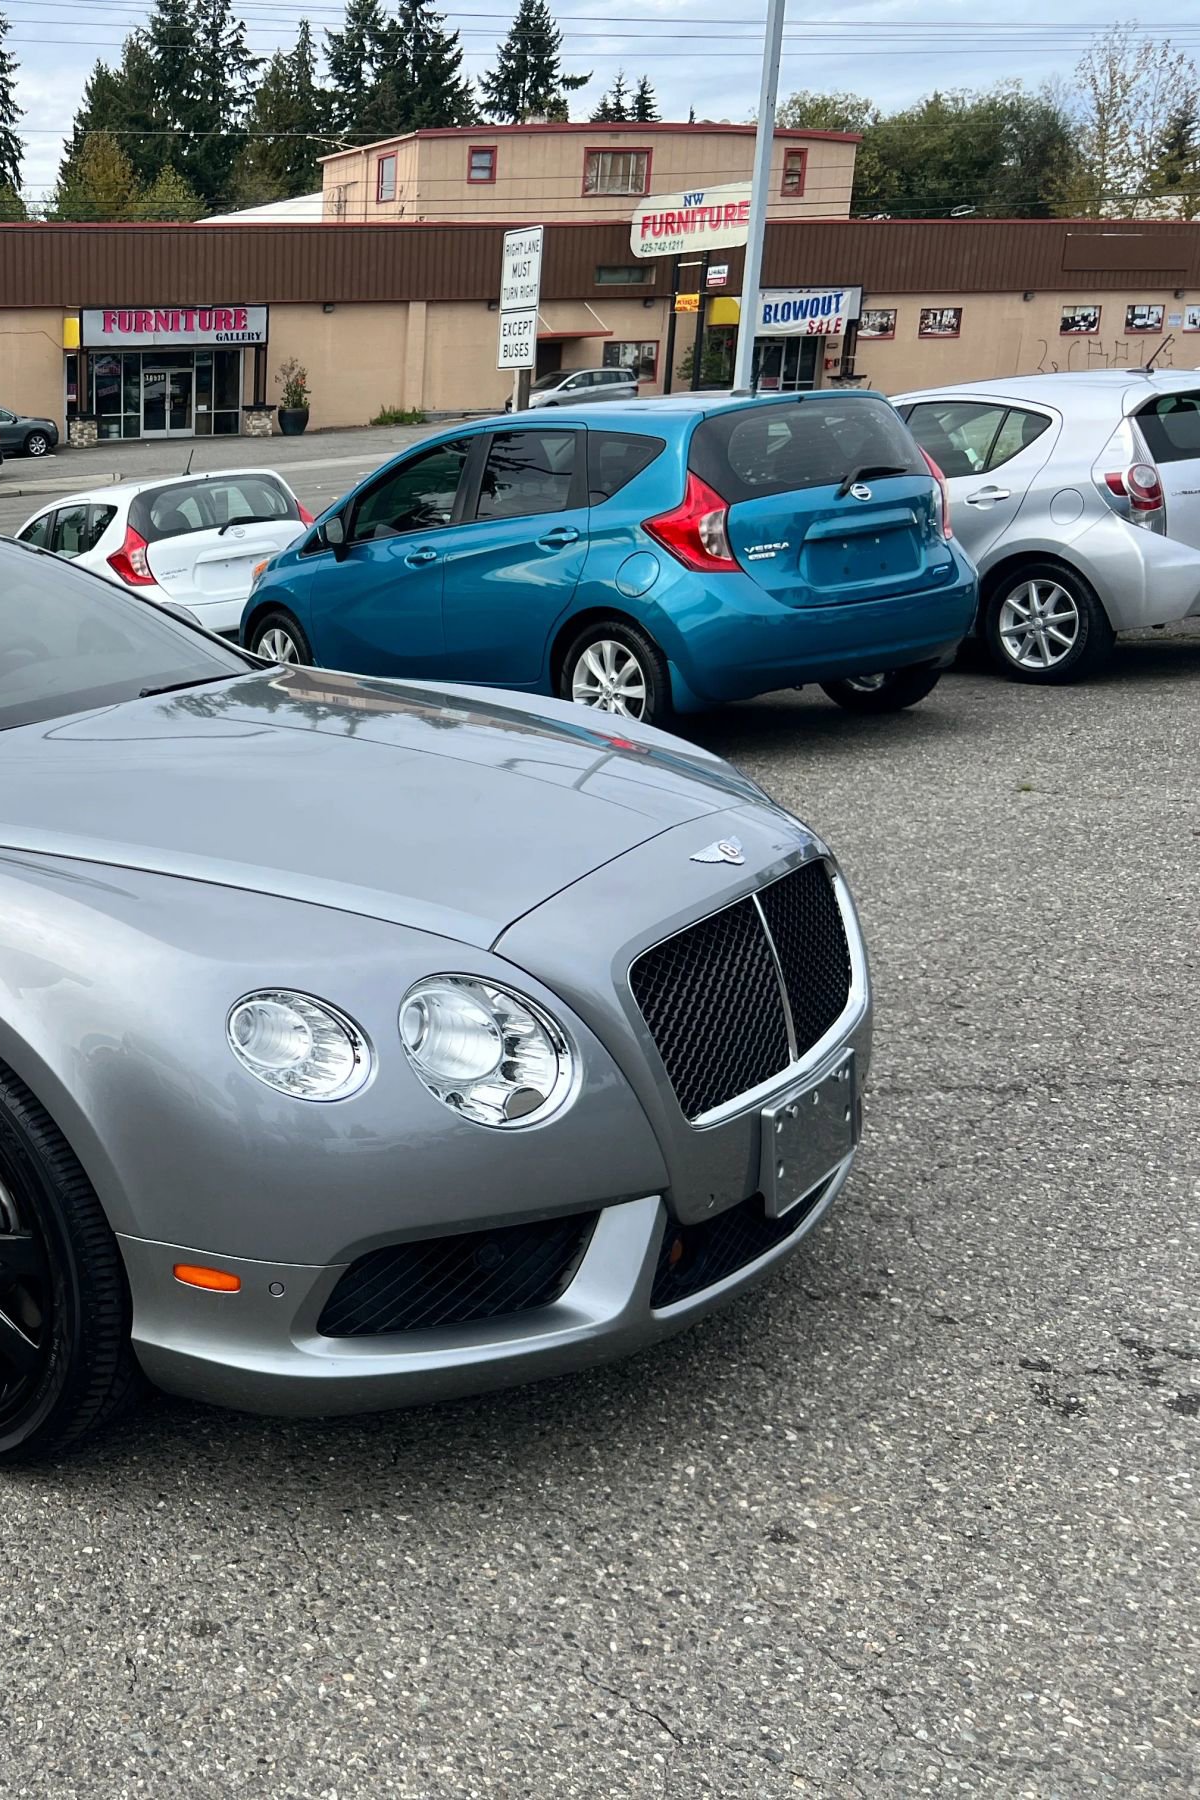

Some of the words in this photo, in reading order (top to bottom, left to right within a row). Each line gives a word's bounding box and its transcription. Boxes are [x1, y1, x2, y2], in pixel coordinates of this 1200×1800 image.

[683, 193, 705, 207] NW
[640, 200, 751, 240] FURNITURE
[506, 241, 524, 257] RIGHT
[524, 239, 540, 255] LANE
[511, 261, 531, 278] MUST
[503, 286, 519, 300] TURN
[519, 283, 537, 299] RIGHT
[762, 293, 843, 324] BLOWOUT
[102, 308, 248, 333] FURNITURE
[503, 320, 533, 337] EXCEPT
[806, 318, 842, 334] SALE
[215, 332, 262, 342] GALLERY
[503, 342, 529, 358] BUSES
[743, 542, 790, 554] VERSA
